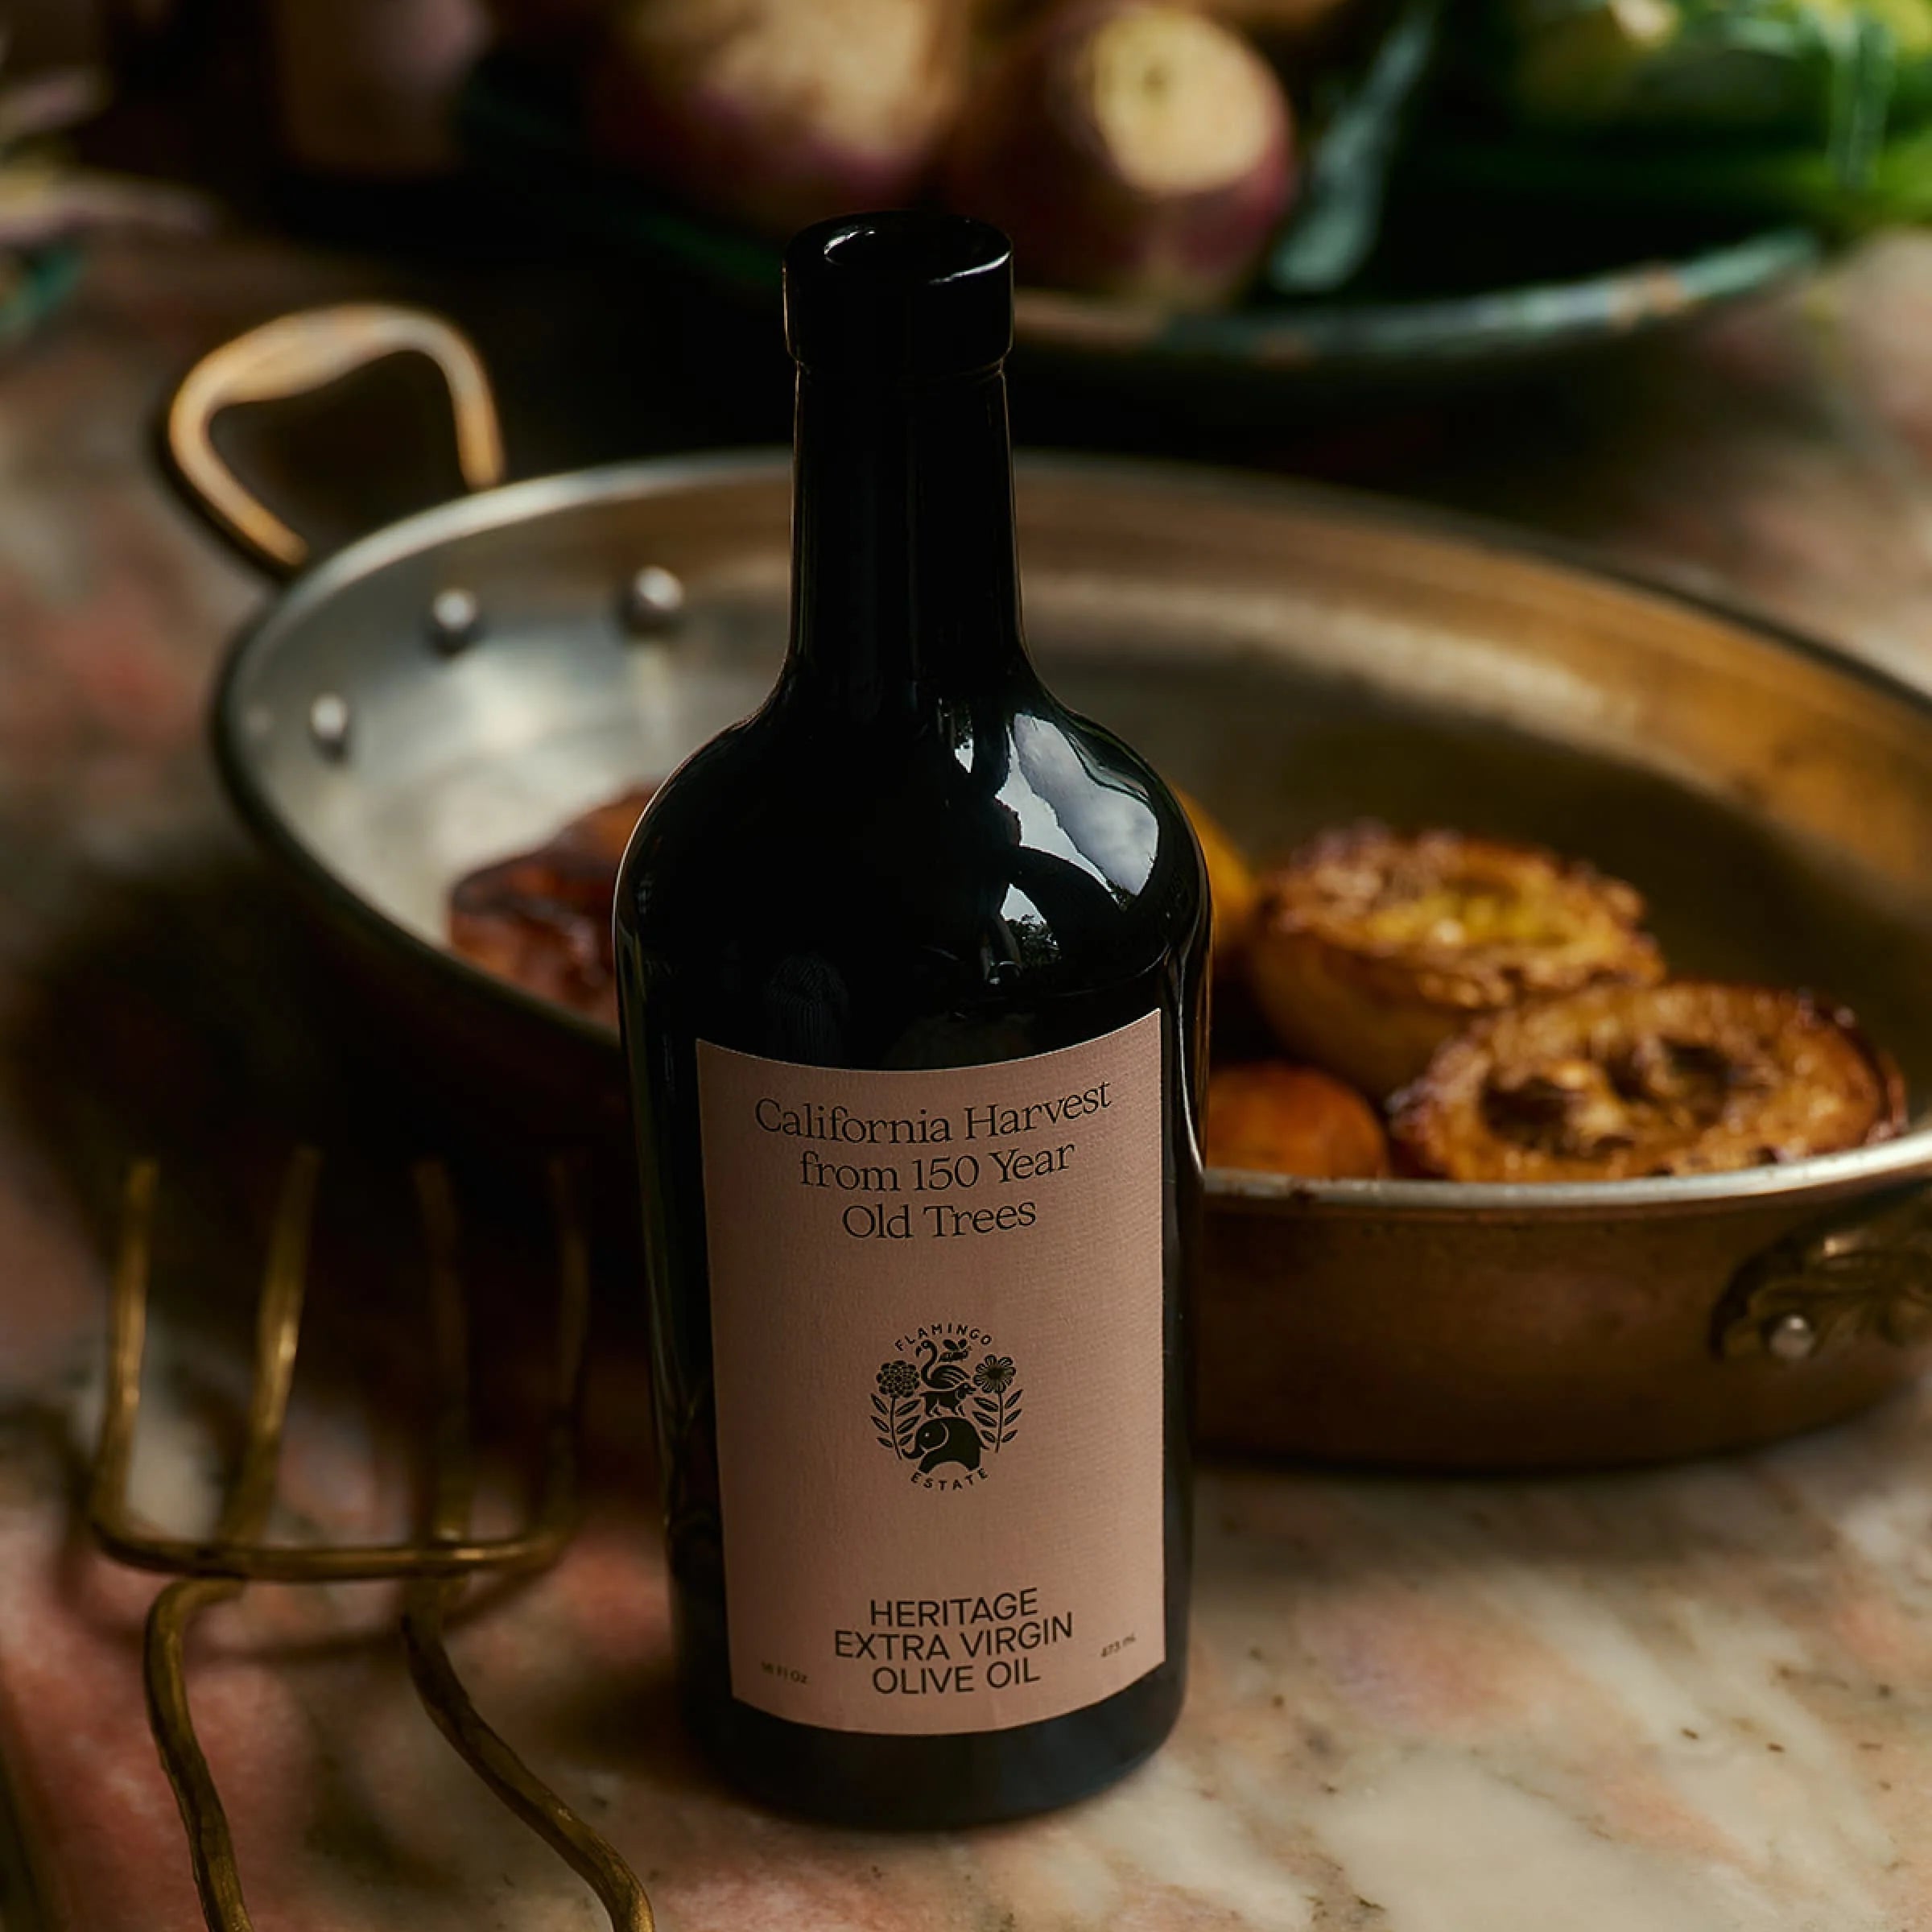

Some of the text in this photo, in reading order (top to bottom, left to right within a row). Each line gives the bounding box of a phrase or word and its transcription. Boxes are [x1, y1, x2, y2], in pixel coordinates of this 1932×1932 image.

[754, 1080, 1113, 1145] California Harvest
[799, 1143, 1075, 1192] from 150 Year
[841, 1200, 1038, 1239] Old Trees
[894, 1323, 993, 1352] FLAMINGO
[910, 1468, 989, 1491] ESTATE
[870, 1587, 1038, 1628] HERITAGE
[835, 1612, 1072, 1662] EXTRA VIRGIN
[872, 1657, 1042, 1695] OLIVE OIL
